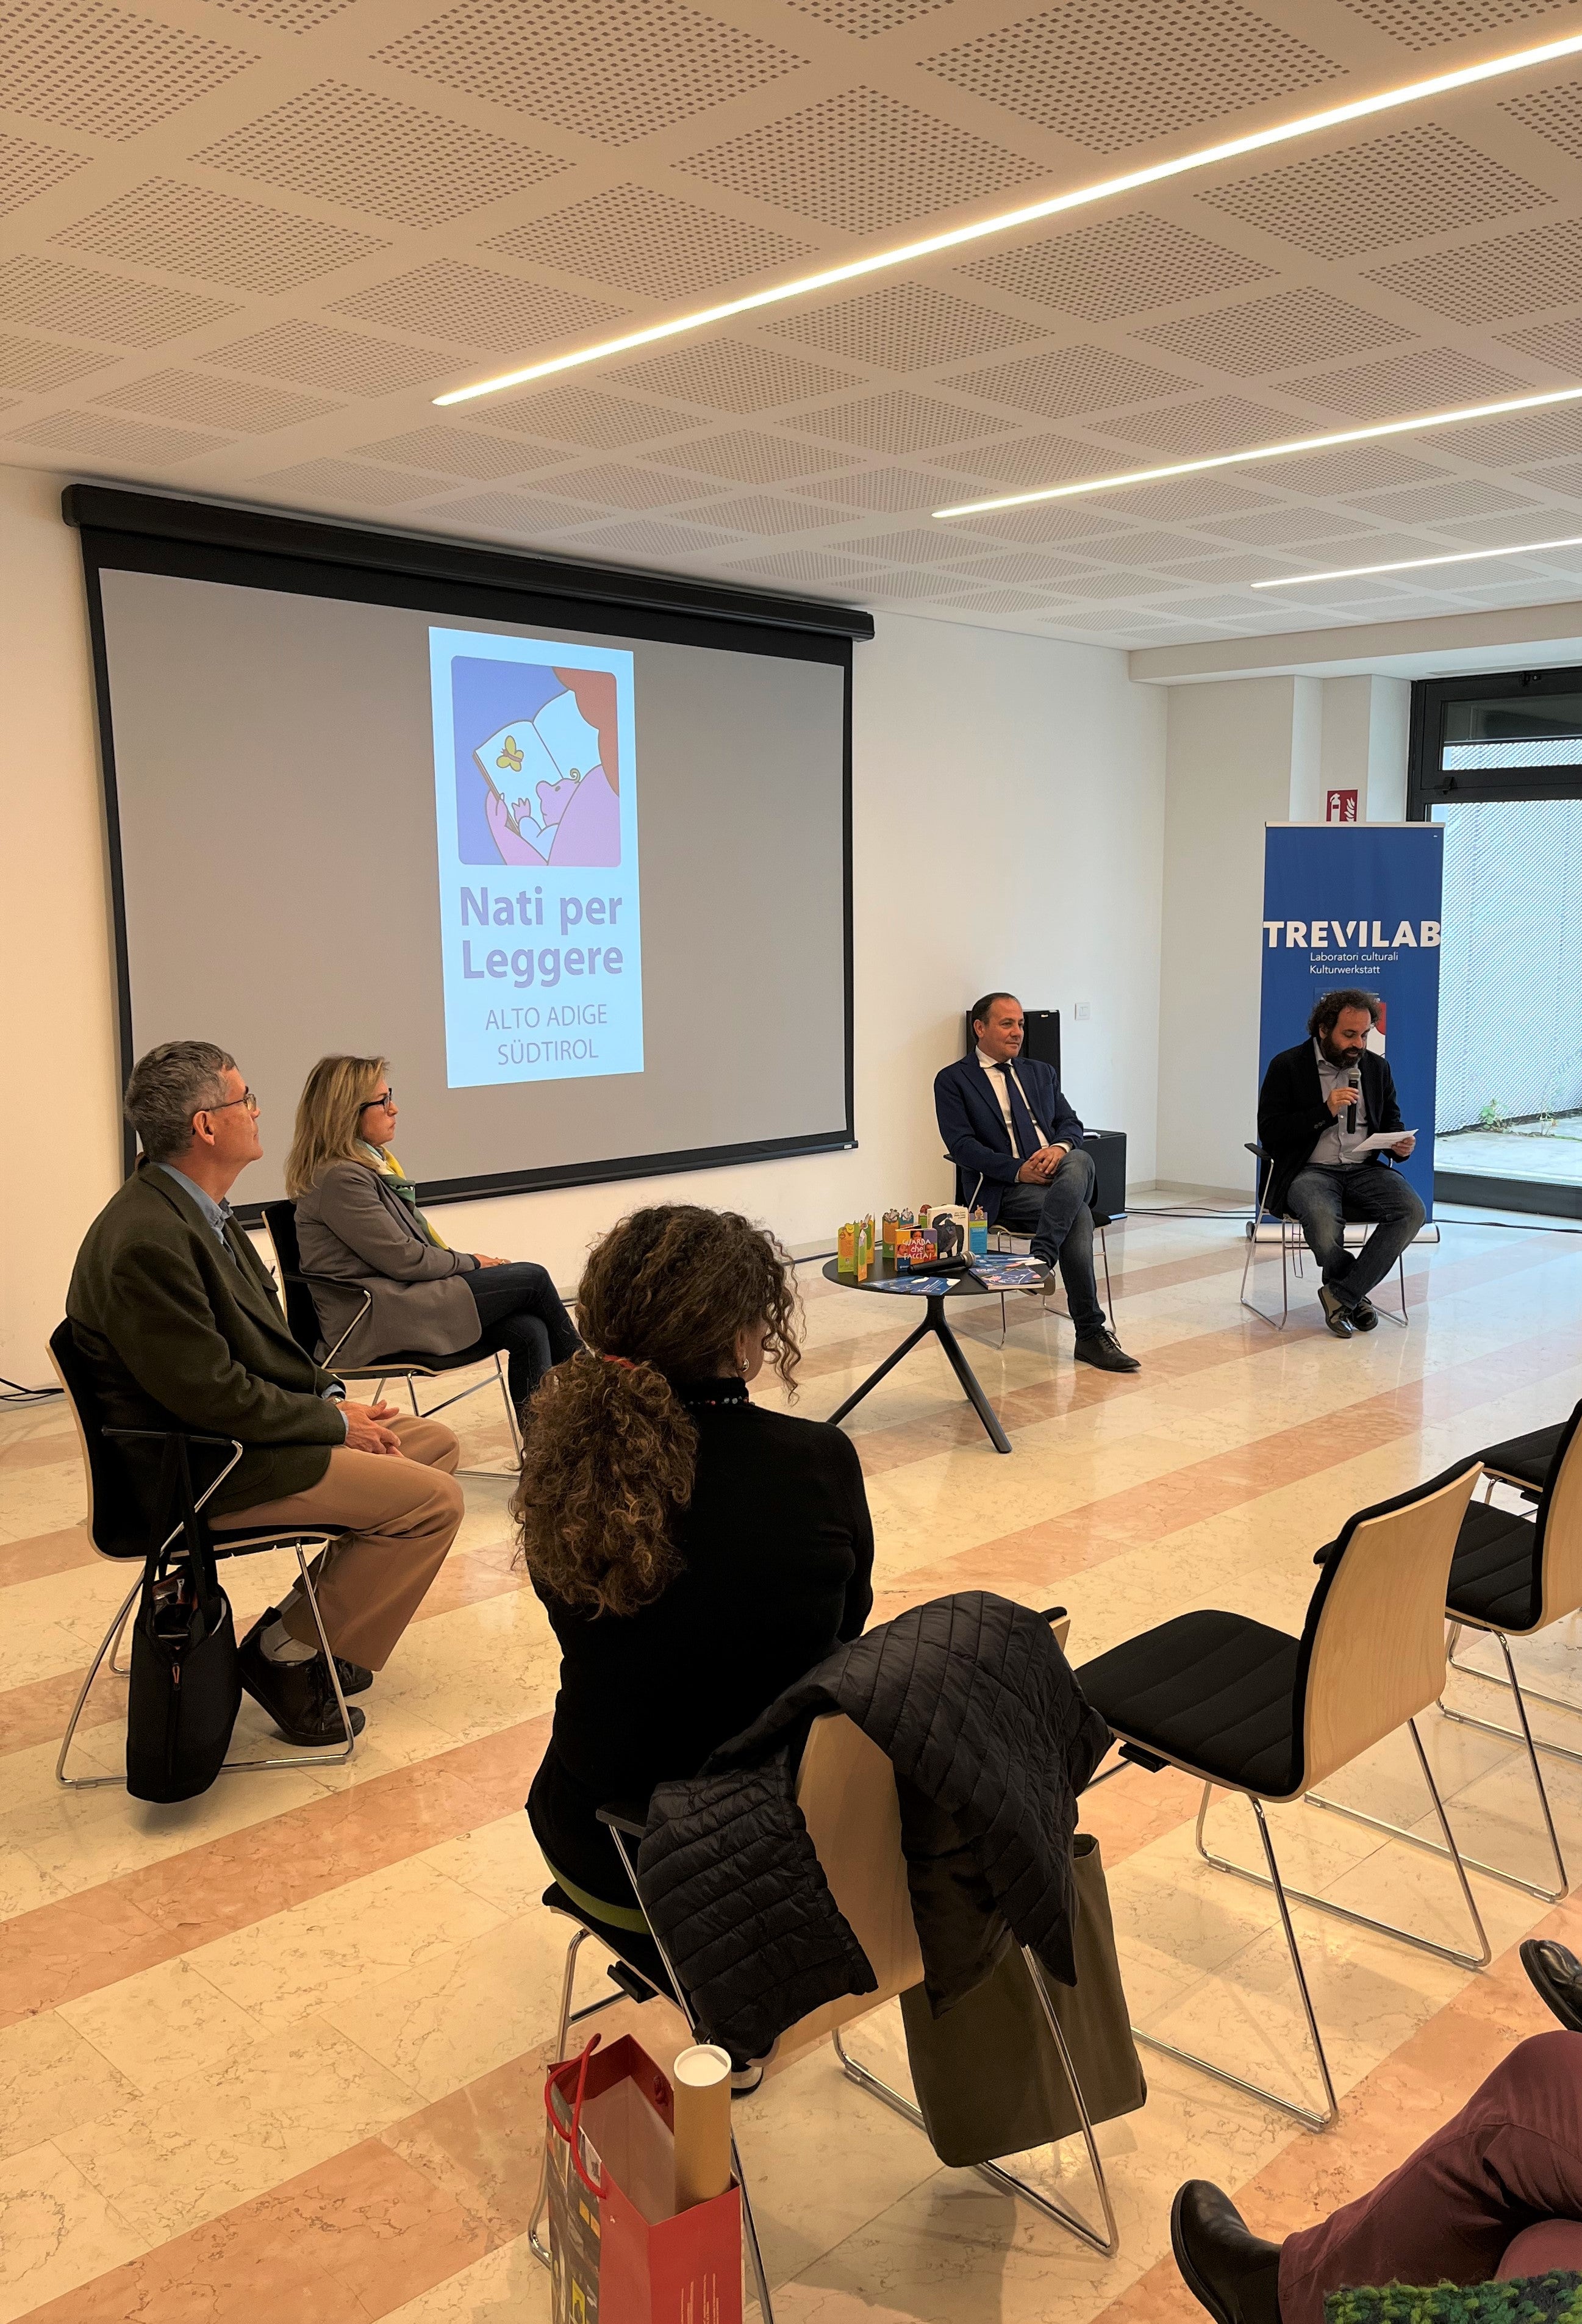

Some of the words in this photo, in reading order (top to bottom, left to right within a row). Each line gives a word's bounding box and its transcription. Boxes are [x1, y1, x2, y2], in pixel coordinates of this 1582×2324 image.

[459, 886, 542, 927] Nati
[560, 896, 623, 935] per
[1263, 920, 1441, 947] TREVILAB
[462, 940, 624, 988] Leggere
[1309, 964, 1381, 974] Kulturwerkstatt
[1310, 952, 1359, 961] Laboratori
[1361, 952, 1398, 961] culturali
[485, 1006, 540, 1031] ALTO
[546, 1004, 608, 1028] ADIGE
[498, 1038, 599, 1066] SÜDTIROL
[911, 1244, 924, 1253] che
